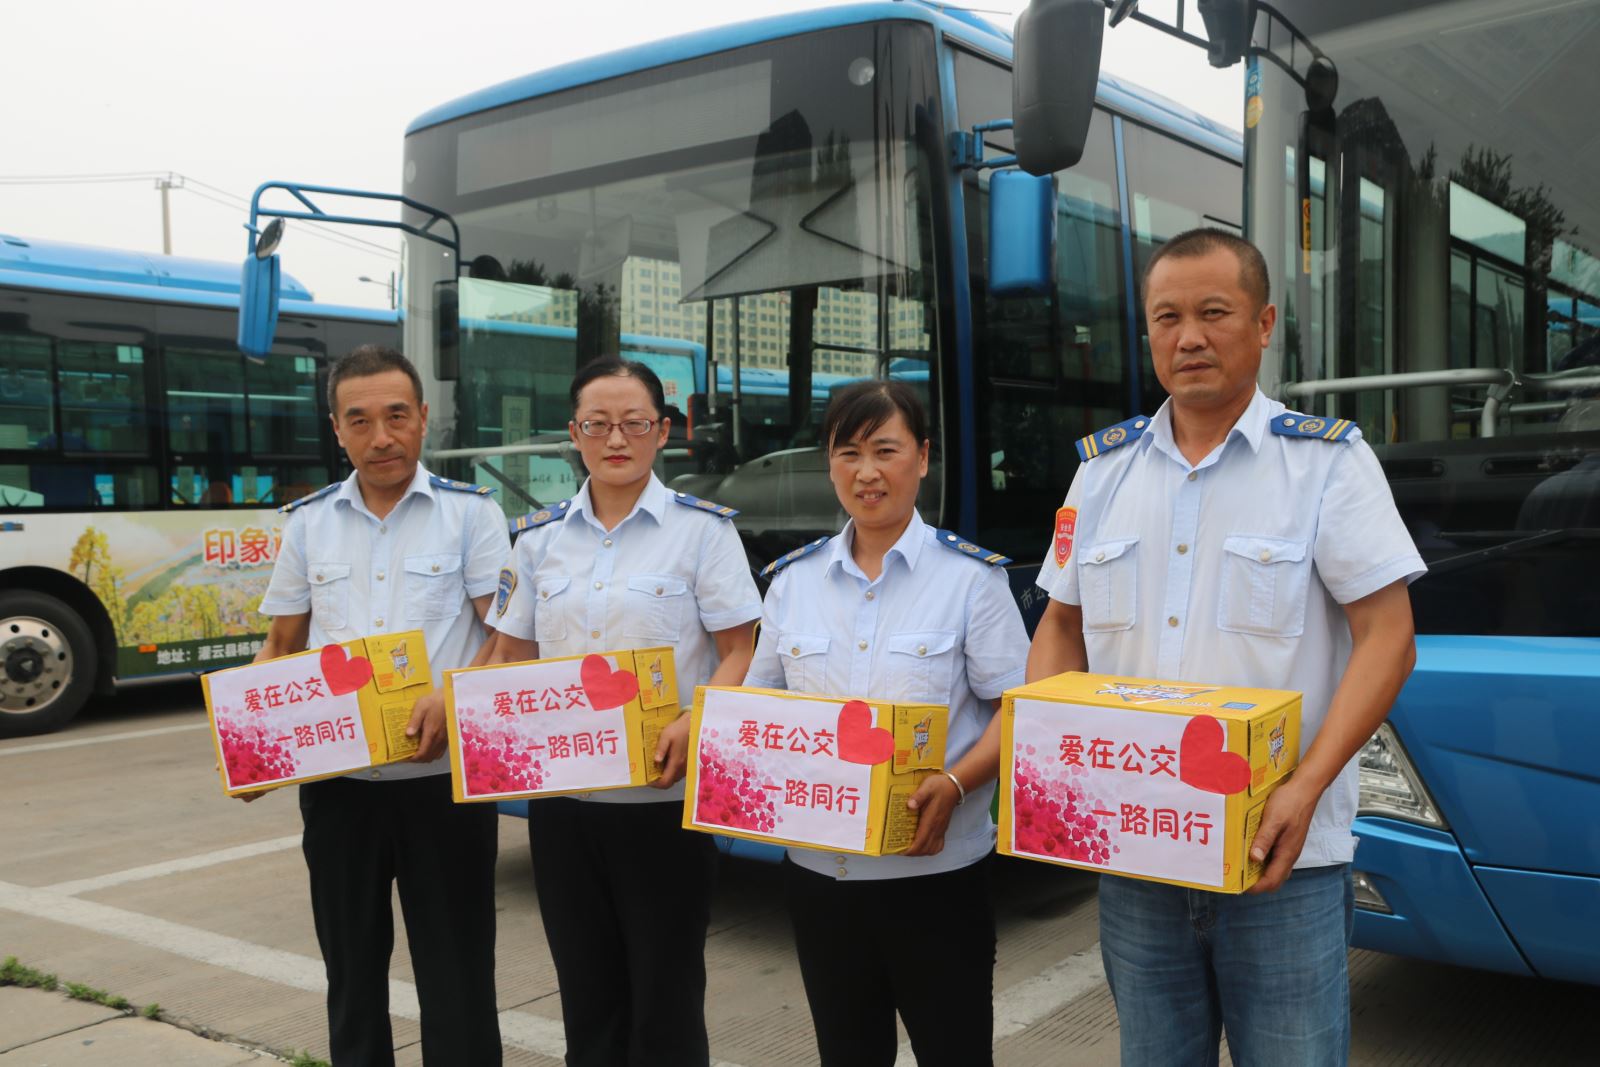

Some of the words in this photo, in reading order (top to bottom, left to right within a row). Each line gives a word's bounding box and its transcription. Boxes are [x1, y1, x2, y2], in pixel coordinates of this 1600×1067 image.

[244, 677, 325, 712] 爱在公交
[493, 684, 586, 717] 爱在公交
[275, 716, 356, 749] 一路同行
[526, 729, 619, 760] 一路同行
[738, 720, 834, 757] 爱在公交
[1059, 735, 1177, 778] 爱在公交
[761, 778, 860, 815] 一路同行
[1091, 803, 1214, 846] 一路同行
